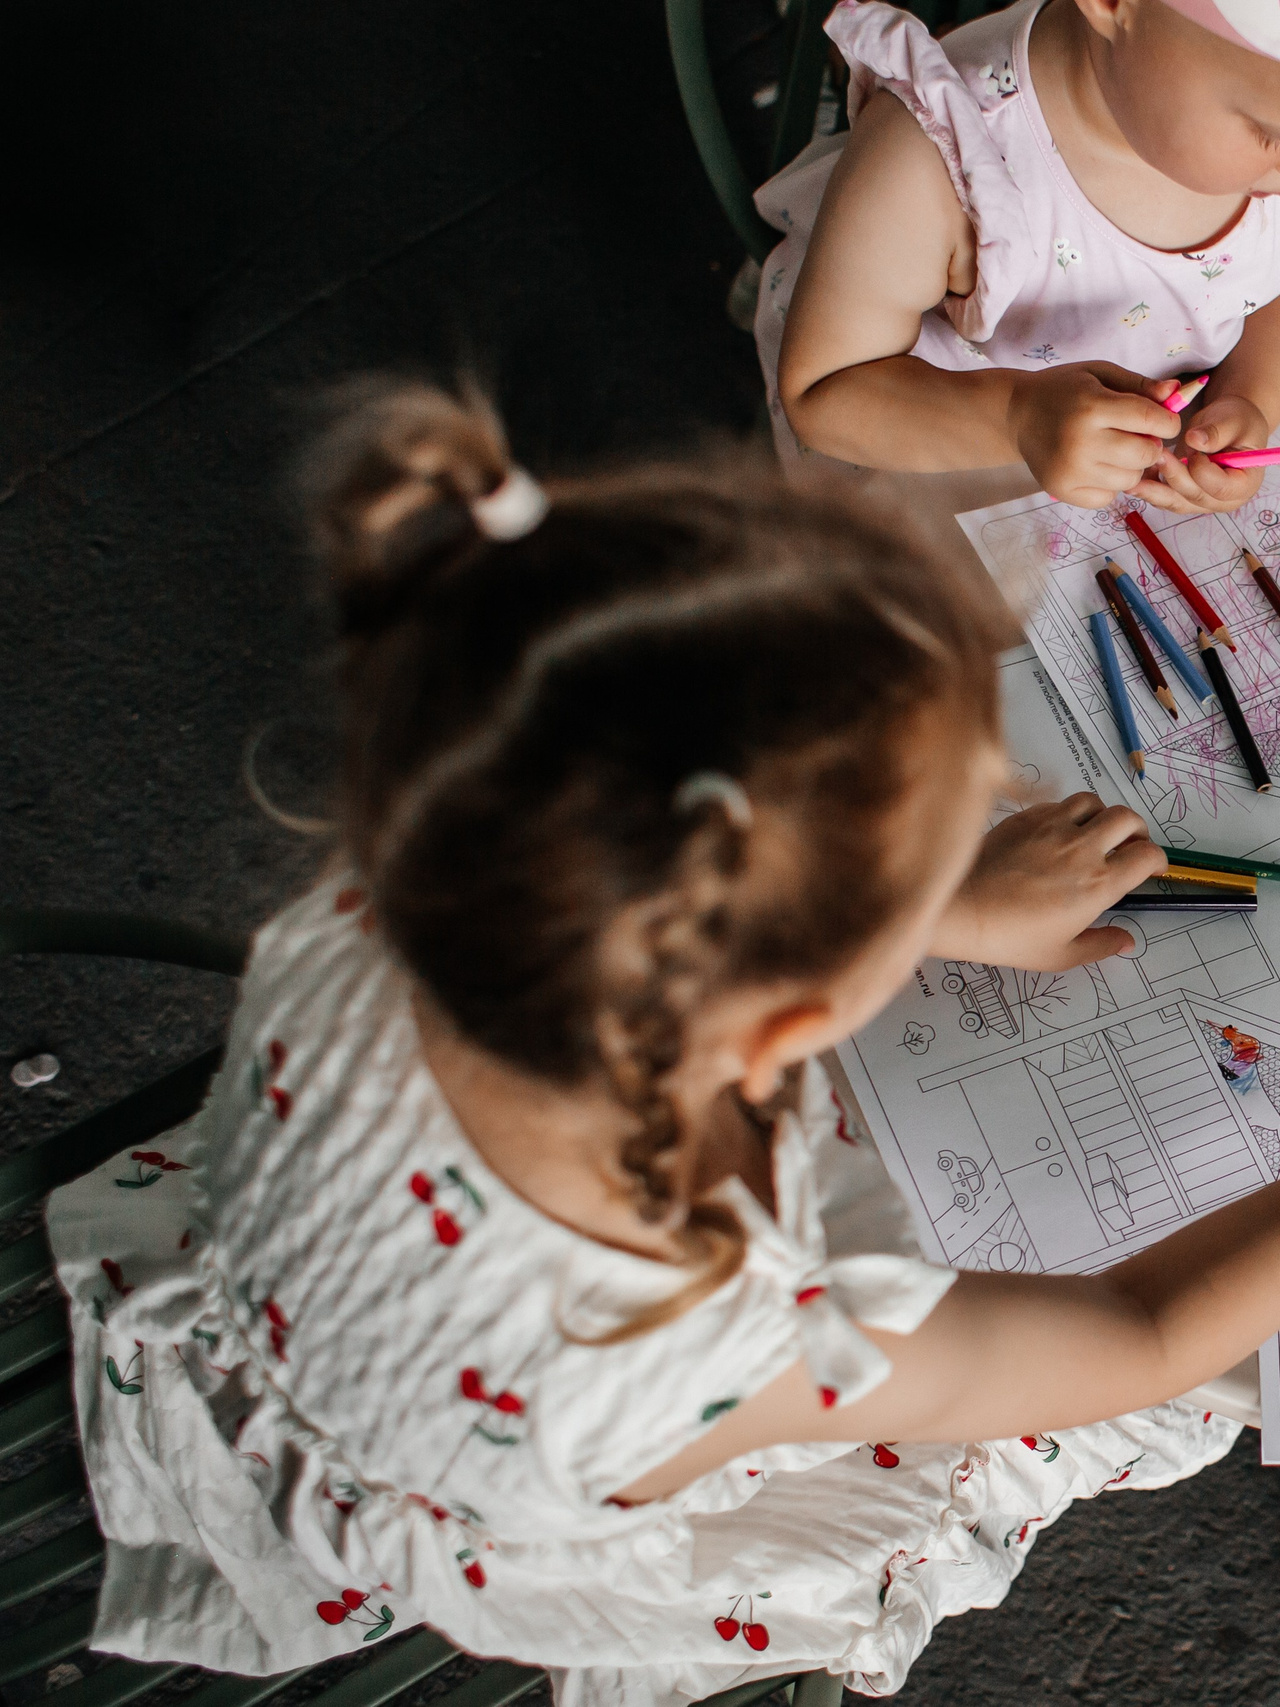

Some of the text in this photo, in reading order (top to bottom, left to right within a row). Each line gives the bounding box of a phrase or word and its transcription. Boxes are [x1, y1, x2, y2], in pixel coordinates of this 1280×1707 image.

[1031, 669, 1045, 685] для
[1039, 683, 1066, 727] любителей
[1059, 726, 1081, 763] поиграть
[1070, 720, 1088, 747] одной
[1082, 746, 1102, 779] комнате
